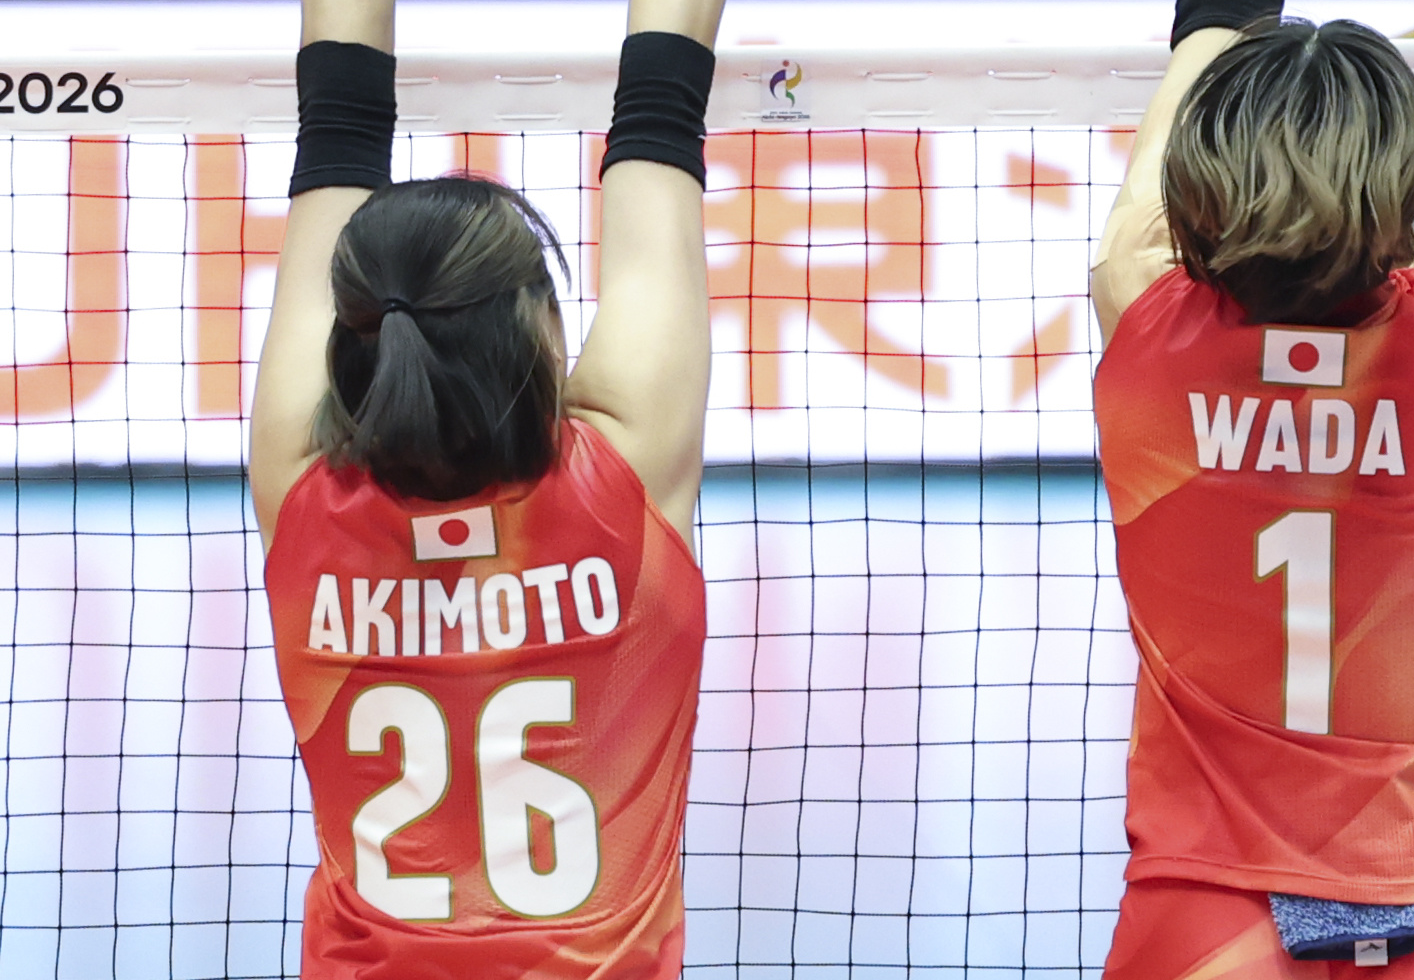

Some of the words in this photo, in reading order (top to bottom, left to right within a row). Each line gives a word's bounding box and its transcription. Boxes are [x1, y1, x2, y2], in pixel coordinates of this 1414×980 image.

[1188, 392, 1405, 476] WADA
[308, 556, 620, 657] AKIMOTO
[1253, 507, 1337, 736] 1
[346, 676, 600, 922] 26
